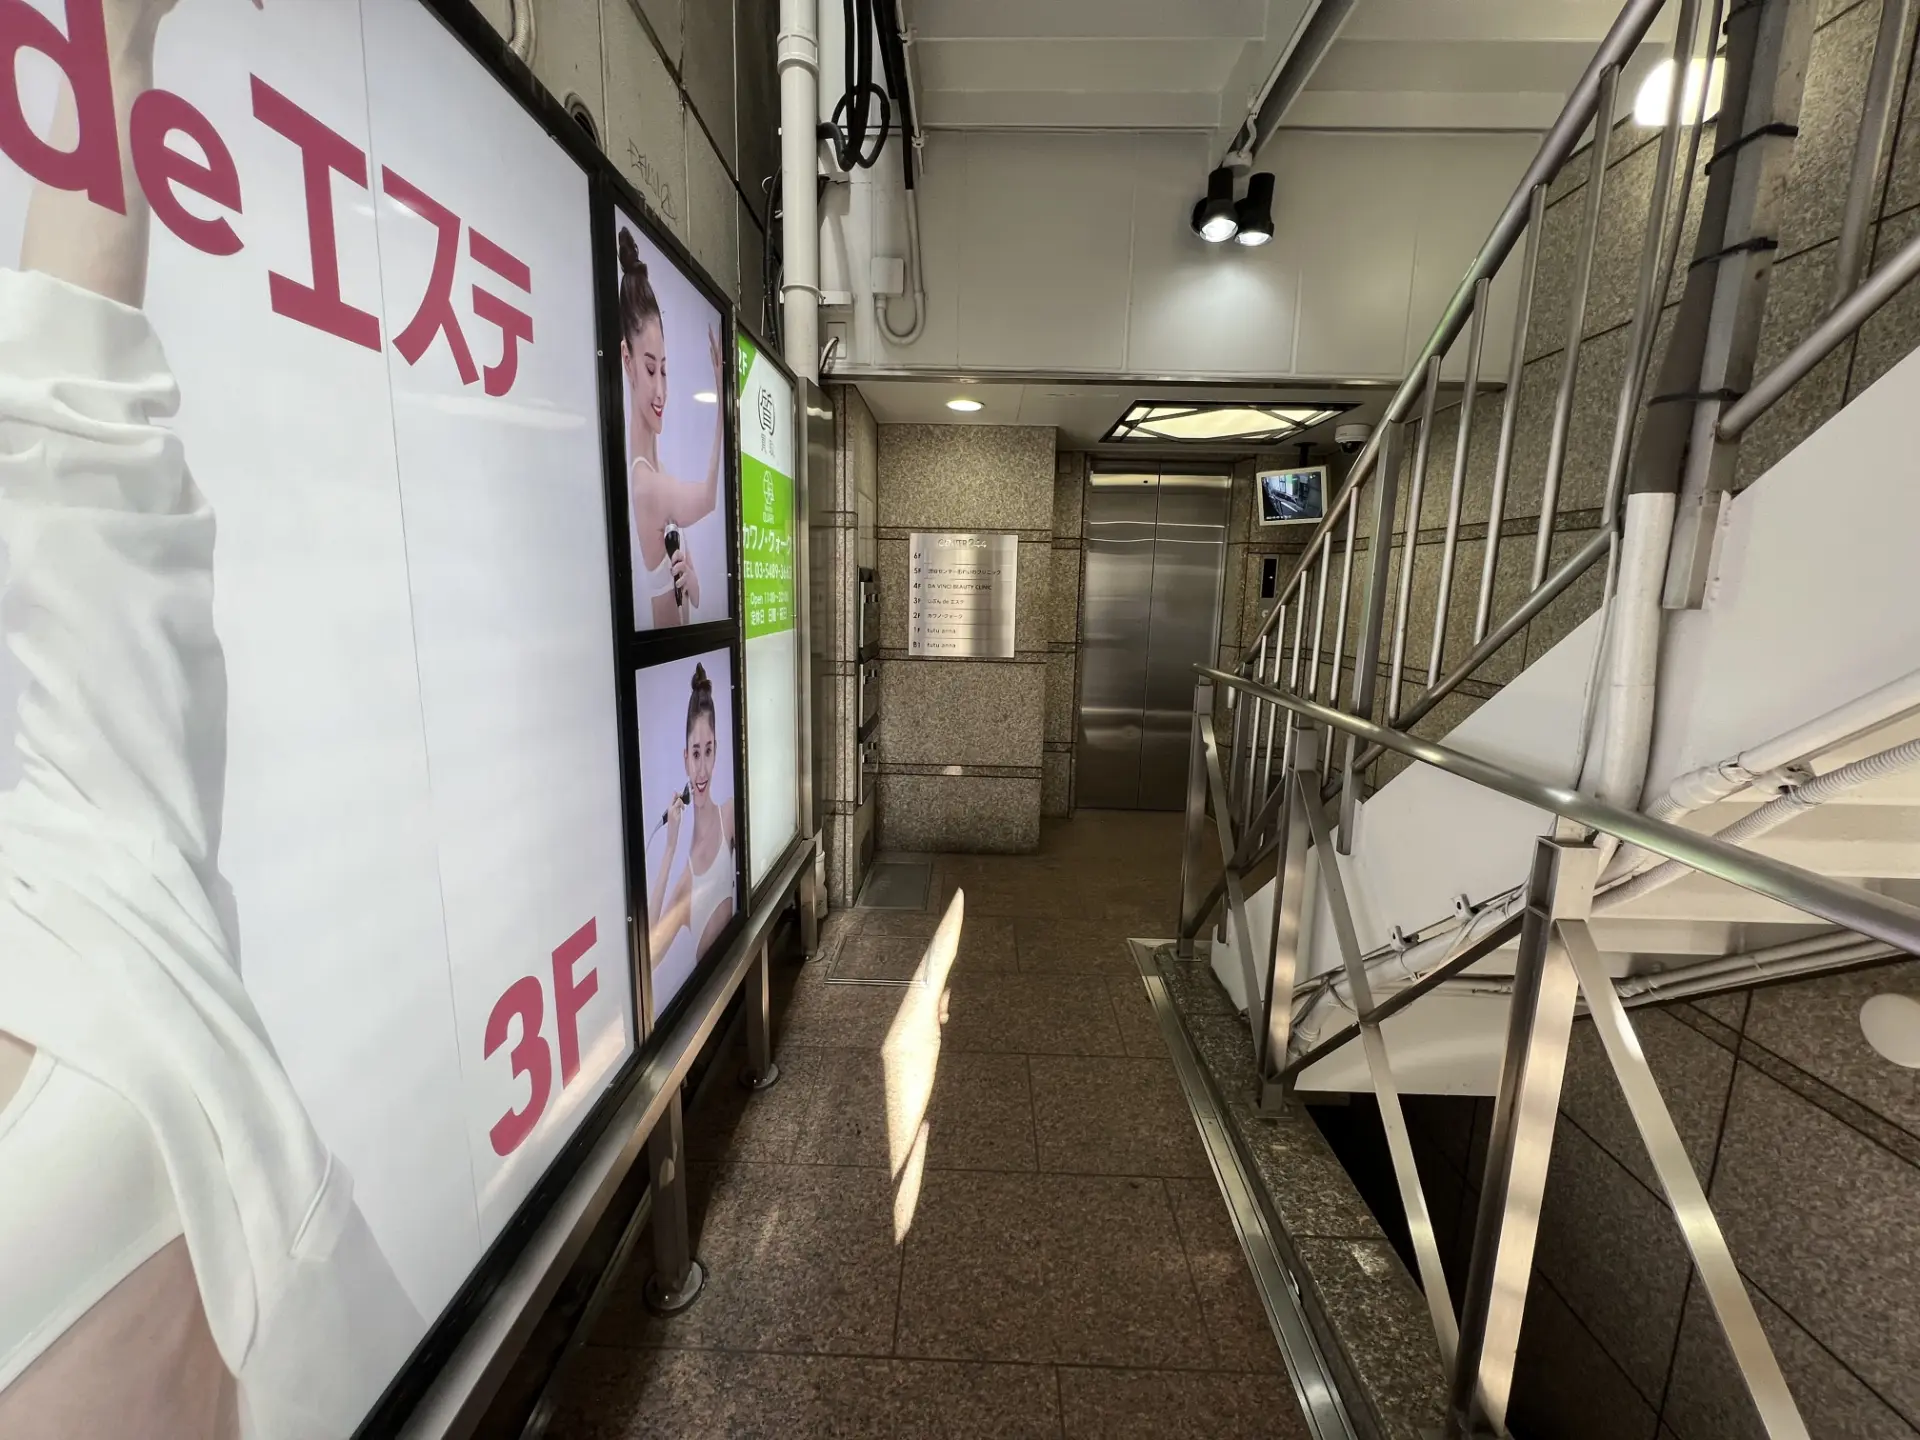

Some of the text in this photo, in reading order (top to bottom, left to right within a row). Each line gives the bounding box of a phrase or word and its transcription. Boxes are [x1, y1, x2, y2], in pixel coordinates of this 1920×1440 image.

[743, 560, 753, 578] TEL
[750, 592, 763, 606] Open
[484, 916, 599, 1156] 3F
